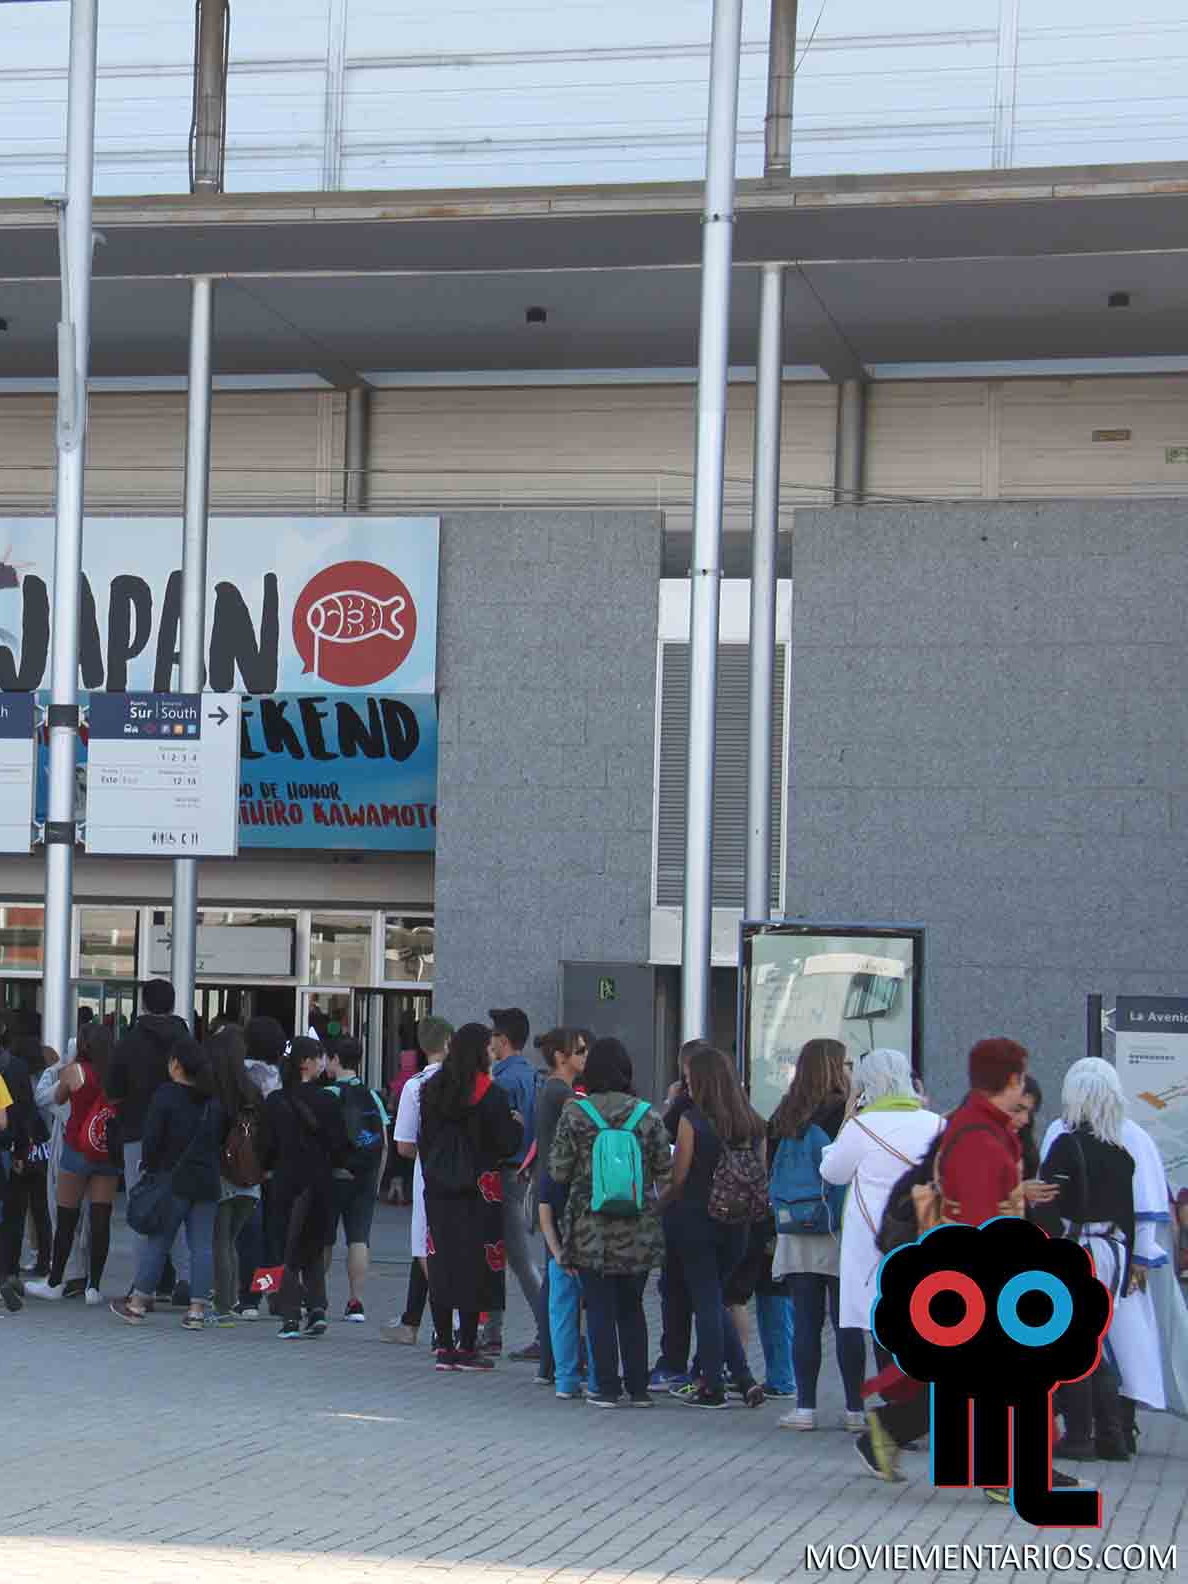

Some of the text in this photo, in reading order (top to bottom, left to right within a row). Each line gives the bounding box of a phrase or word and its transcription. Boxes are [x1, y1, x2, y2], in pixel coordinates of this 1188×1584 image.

[130, 706, 197, 720] Sur South
[241, 695, 420, 762] EKEND
[260, 782, 278, 800] DE
[287, 782, 342, 800] HONOR
[1129, 1011, 1144, 1022] La
